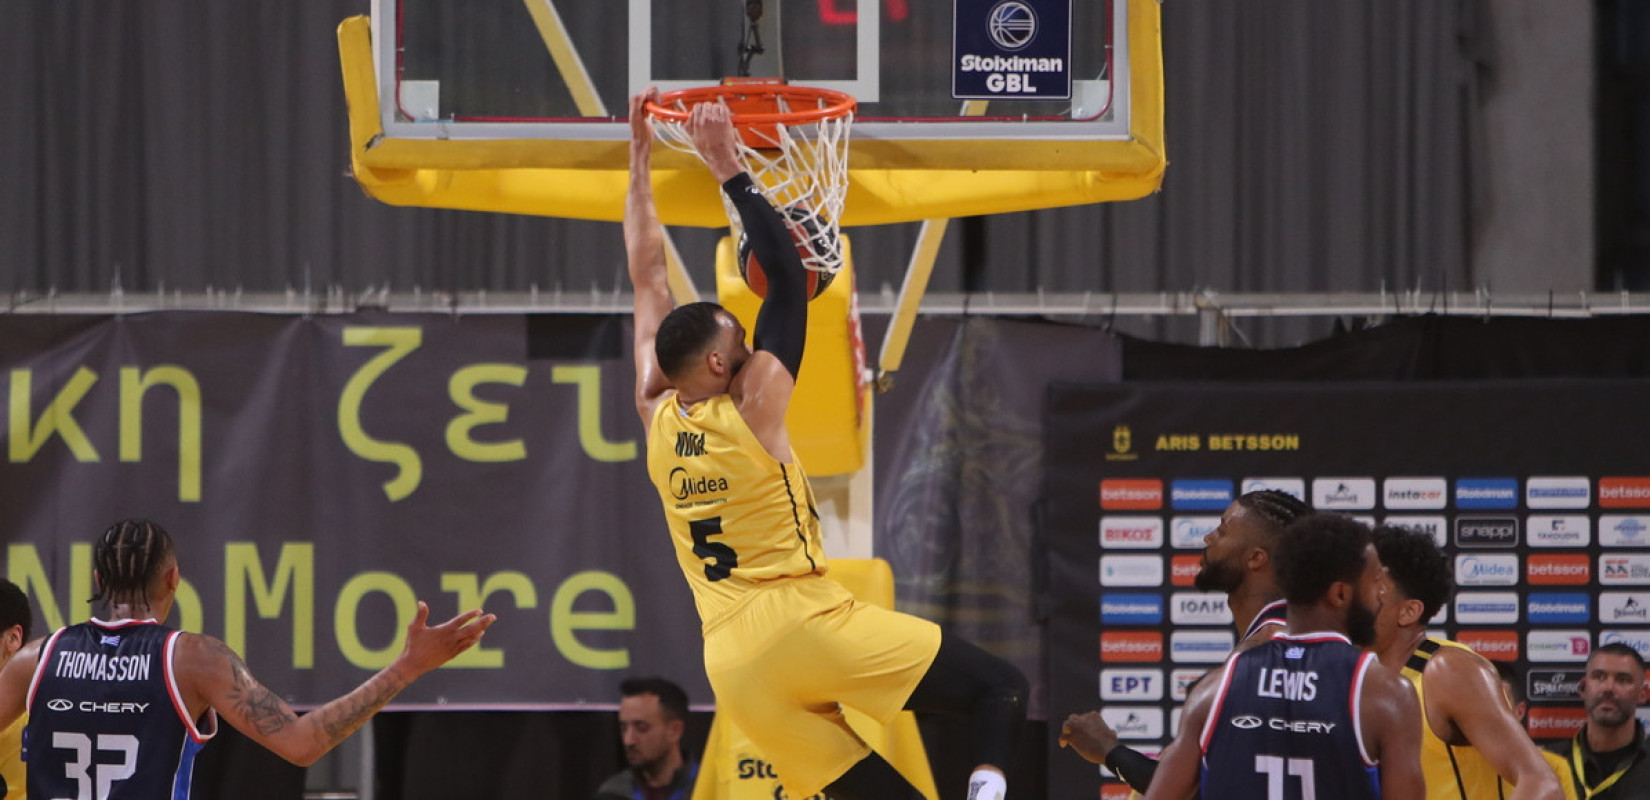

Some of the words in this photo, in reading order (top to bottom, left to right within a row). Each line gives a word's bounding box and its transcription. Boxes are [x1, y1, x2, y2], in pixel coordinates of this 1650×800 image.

[960, 54, 1063, 73] Stoiximan
[985, 73, 1037, 93] GBL
[337, 326, 638, 503] ζει
[1155, 434, 1200, 450] ARIS
[1208, 434, 1299, 450] BETSSON
[671, 472, 728, 499] Midea
[1101, 488, 1162, 501] betsson
[1388, 490, 1441, 500] instacar
[689, 516, 738, 582] 5
[1463, 558, 1513, 575] Midea
[1529, 562, 1588, 576] betsson
[1101, 640, 1162, 652] betsson
[56, 651, 151, 681] THOMASSON
[1257, 667, 1319, 701] LEWIS
[79, 702, 150, 714] CHERY
[1268, 718, 1336, 734] CHERY
[52, 731, 140, 800] 32
[1255, 755, 1316, 800] 11
